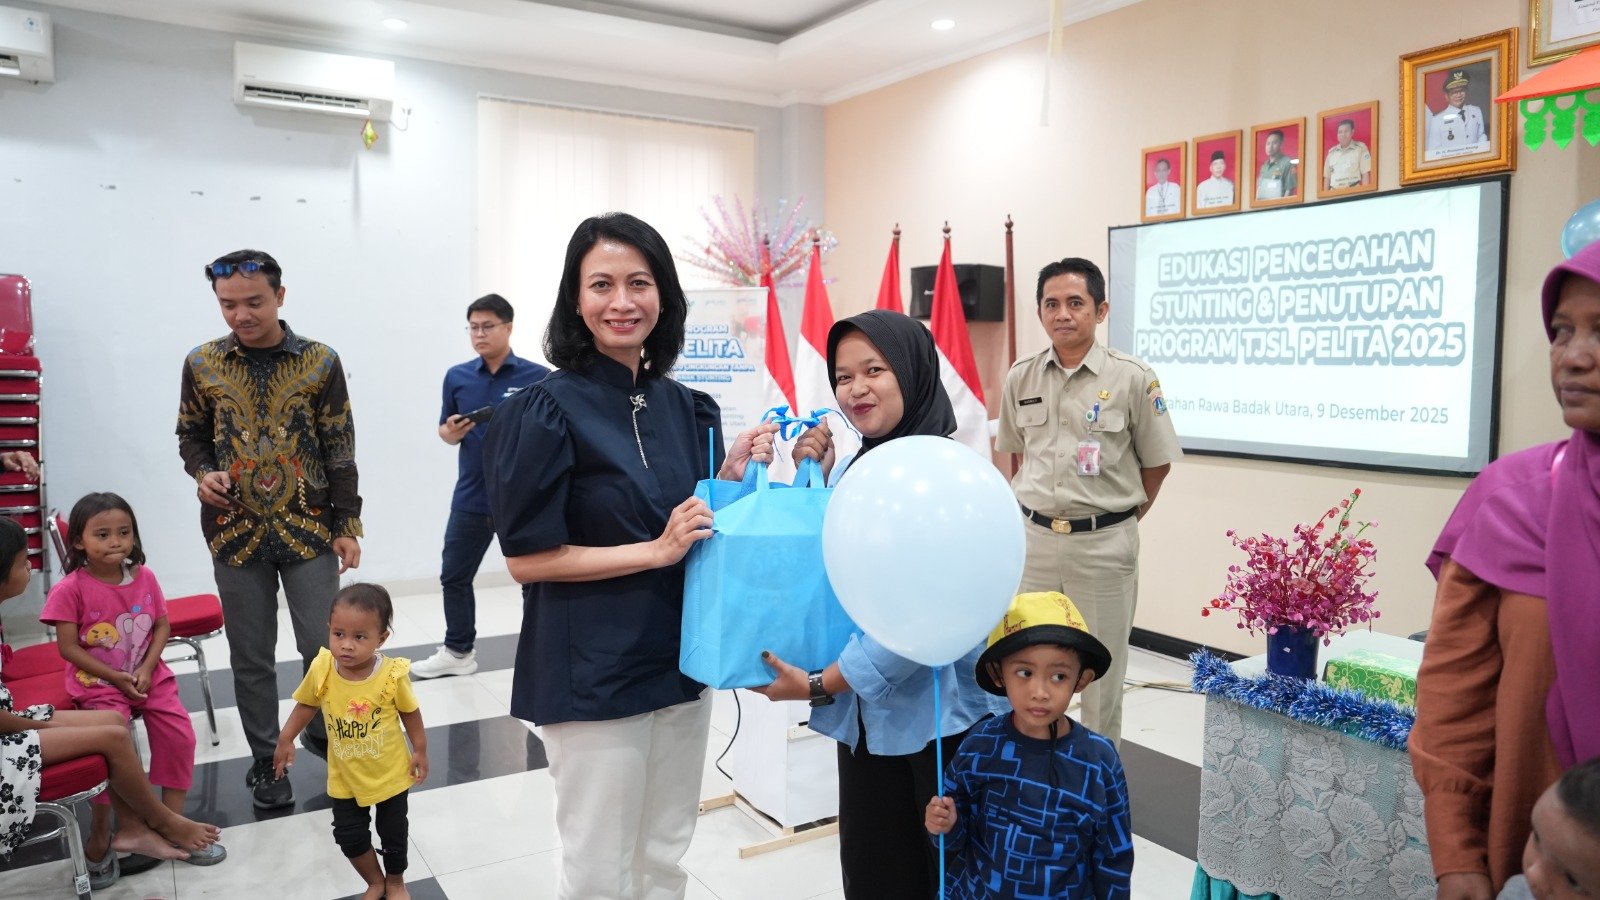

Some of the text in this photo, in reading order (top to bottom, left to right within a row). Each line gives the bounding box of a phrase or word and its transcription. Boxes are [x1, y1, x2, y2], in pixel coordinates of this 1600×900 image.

[1159, 230, 1434, 286] EDUKASI PENCEGAHAN
[1151, 276, 1442, 324] STUNTING & PENUTUPAN
[685, 325, 728, 334] ROGRAM
[1136, 322, 1465, 366] PROGRAM TJSL PELITA 2025
[684, 338, 744, 358] ELITA
[1198, 398, 1230, 413] Rawa
[1233, 399, 1271, 415] Badak
[1275, 401, 1313, 420] Utara,
[1317, 403, 1325, 418] 9
[1330, 403, 1406, 423] Desember
[1410, 406, 1449, 424] 2025
